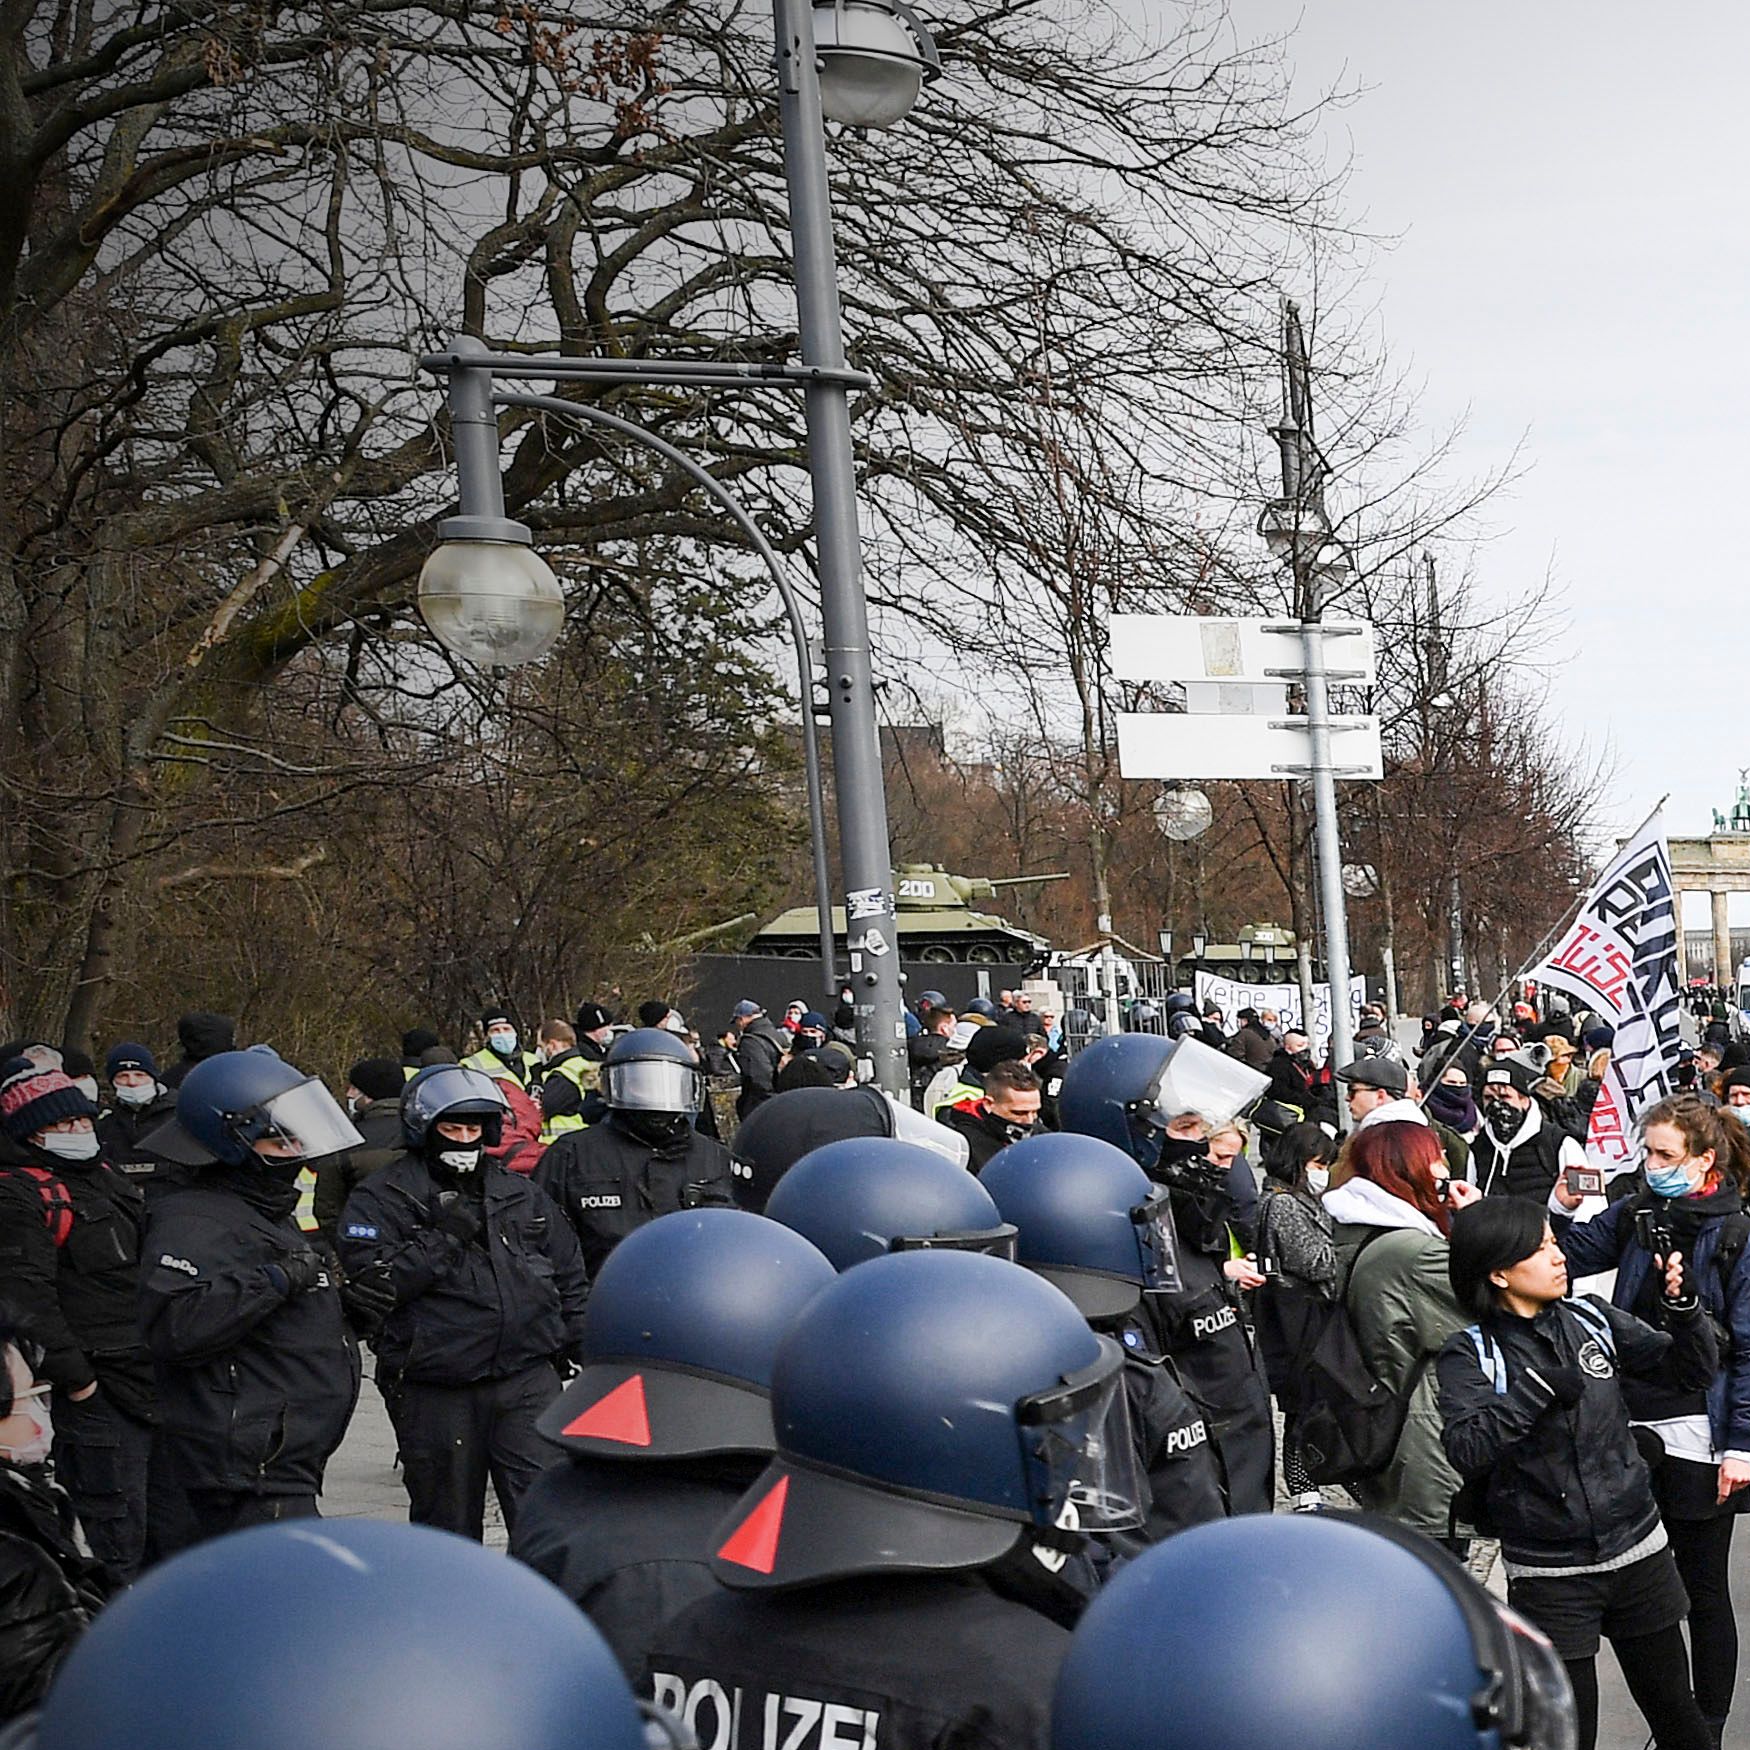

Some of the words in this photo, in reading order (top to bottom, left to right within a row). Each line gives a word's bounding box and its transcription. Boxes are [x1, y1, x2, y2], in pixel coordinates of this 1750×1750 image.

[898, 879, 936, 898] 200
[1200, 976, 1266, 1010] Keine
[580, 1195, 622, 1209] POLIZEI
